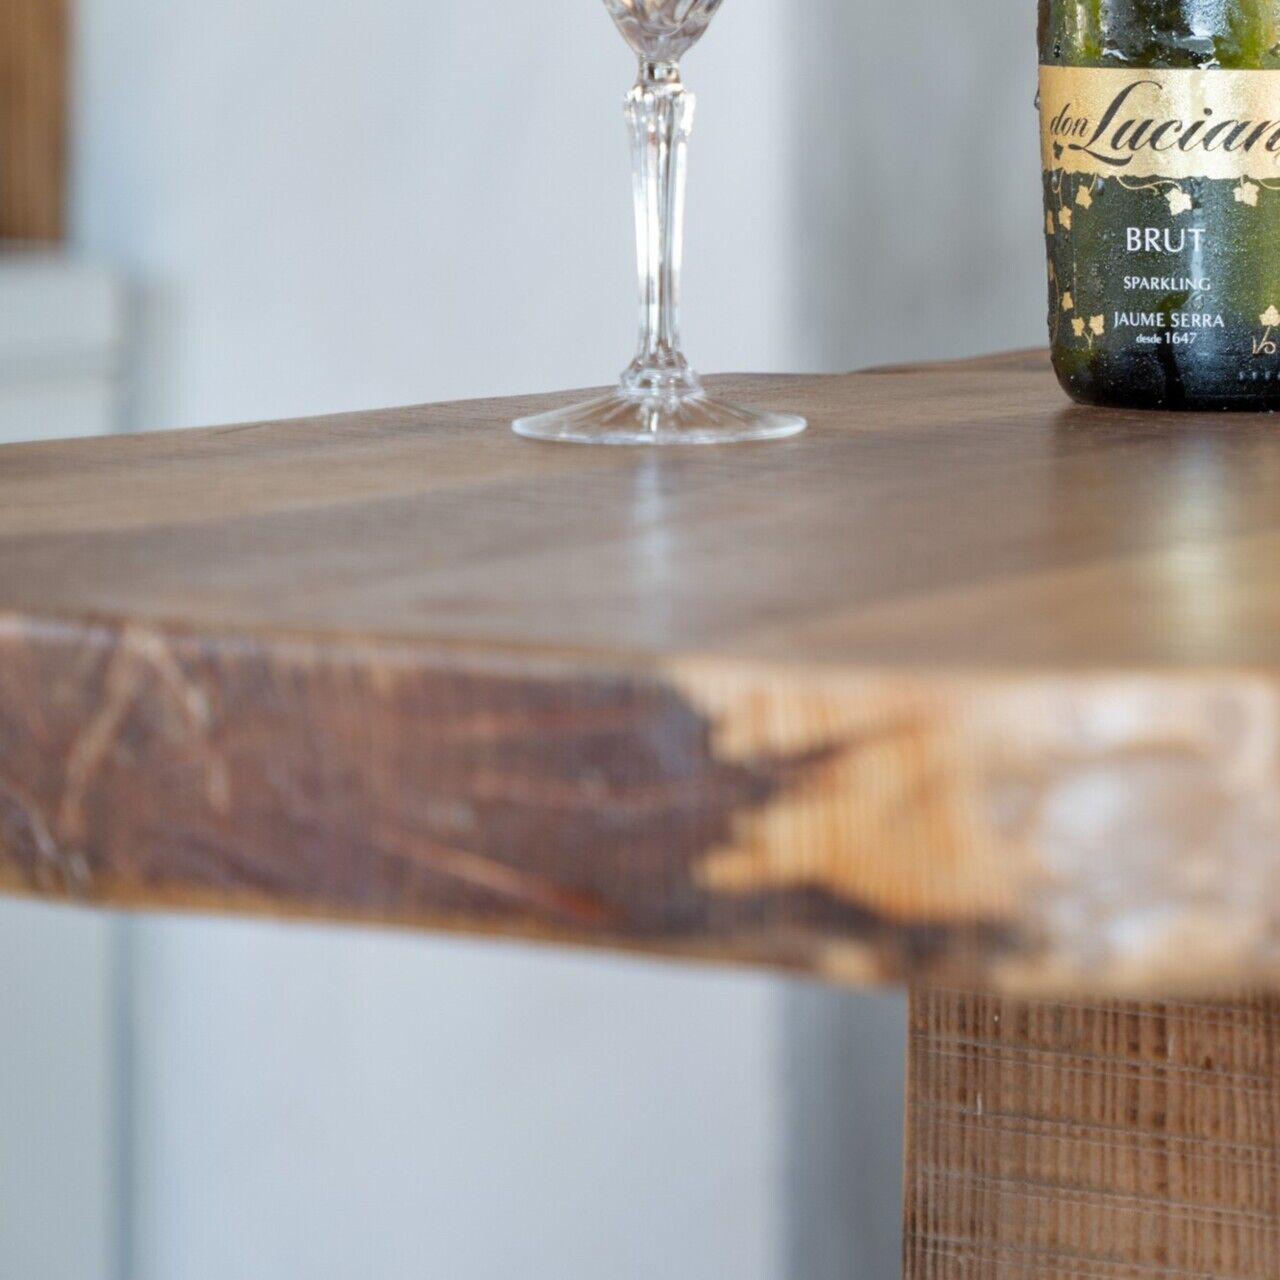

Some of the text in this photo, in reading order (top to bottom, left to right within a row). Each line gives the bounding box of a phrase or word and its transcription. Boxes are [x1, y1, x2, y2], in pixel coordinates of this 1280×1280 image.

[1049, 102, 1090, 138] don
[1126, 226, 1206, 253] BRUT
[1123, 276, 1211, 292] SPARKLING
[1113, 311, 1225, 329] JAUME SERRA
[1135, 331, 1197, 345] desde 1647
